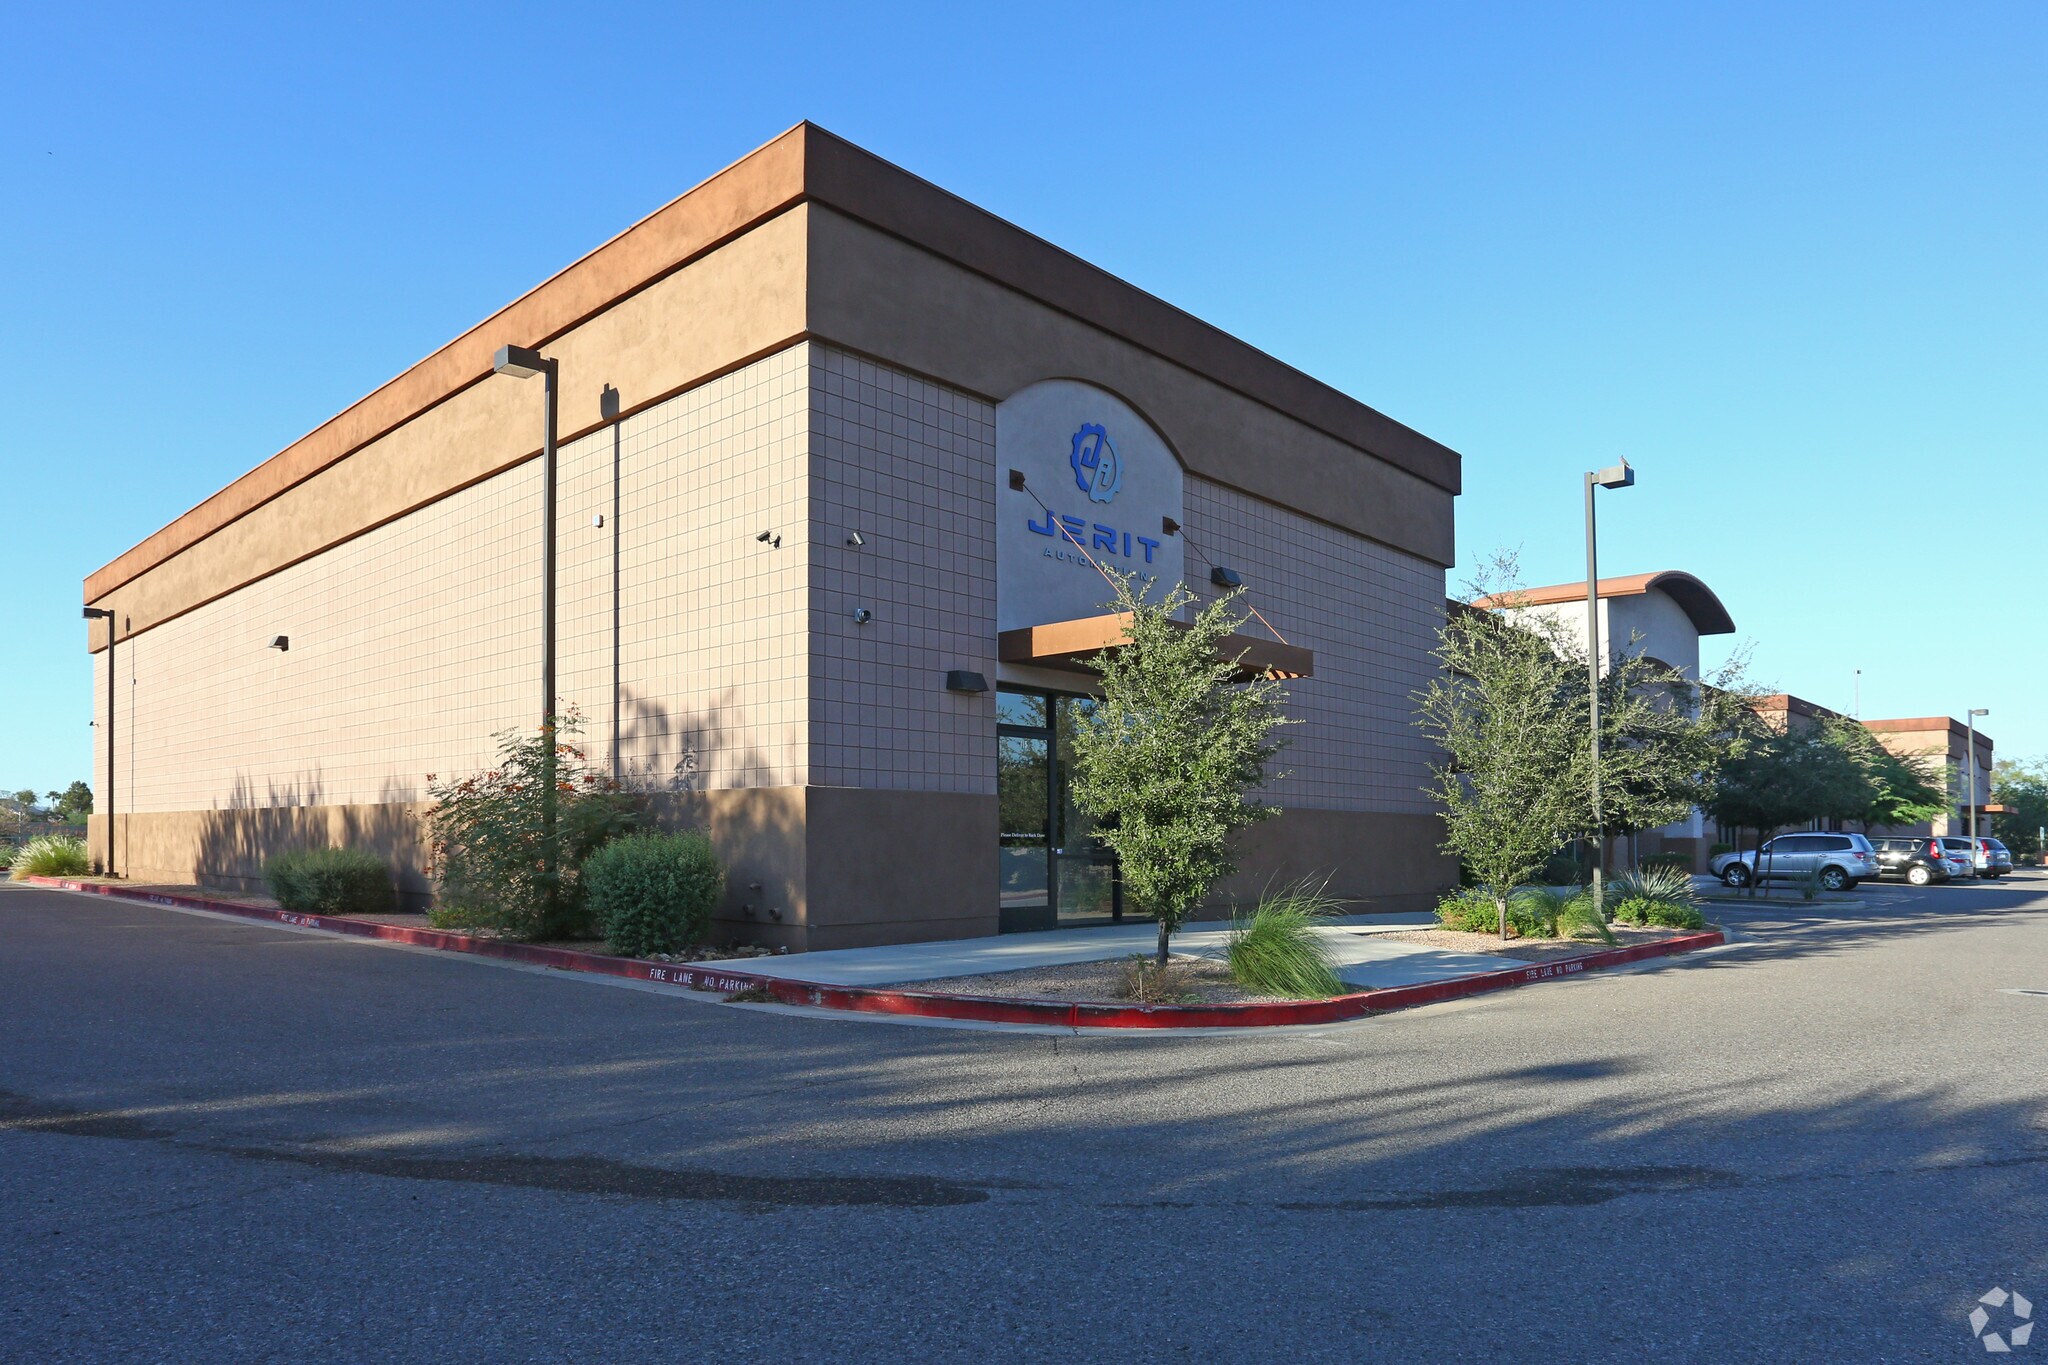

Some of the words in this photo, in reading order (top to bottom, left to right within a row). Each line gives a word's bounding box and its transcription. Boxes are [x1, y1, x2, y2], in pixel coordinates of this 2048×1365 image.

[1028, 510, 1160, 563] JERIT
[1565, 962, 1583, 973] PARKING
[649, 968, 666, 980] FIRE
[673, 972, 693, 984] LANE
[704, 975, 715, 987] NO
